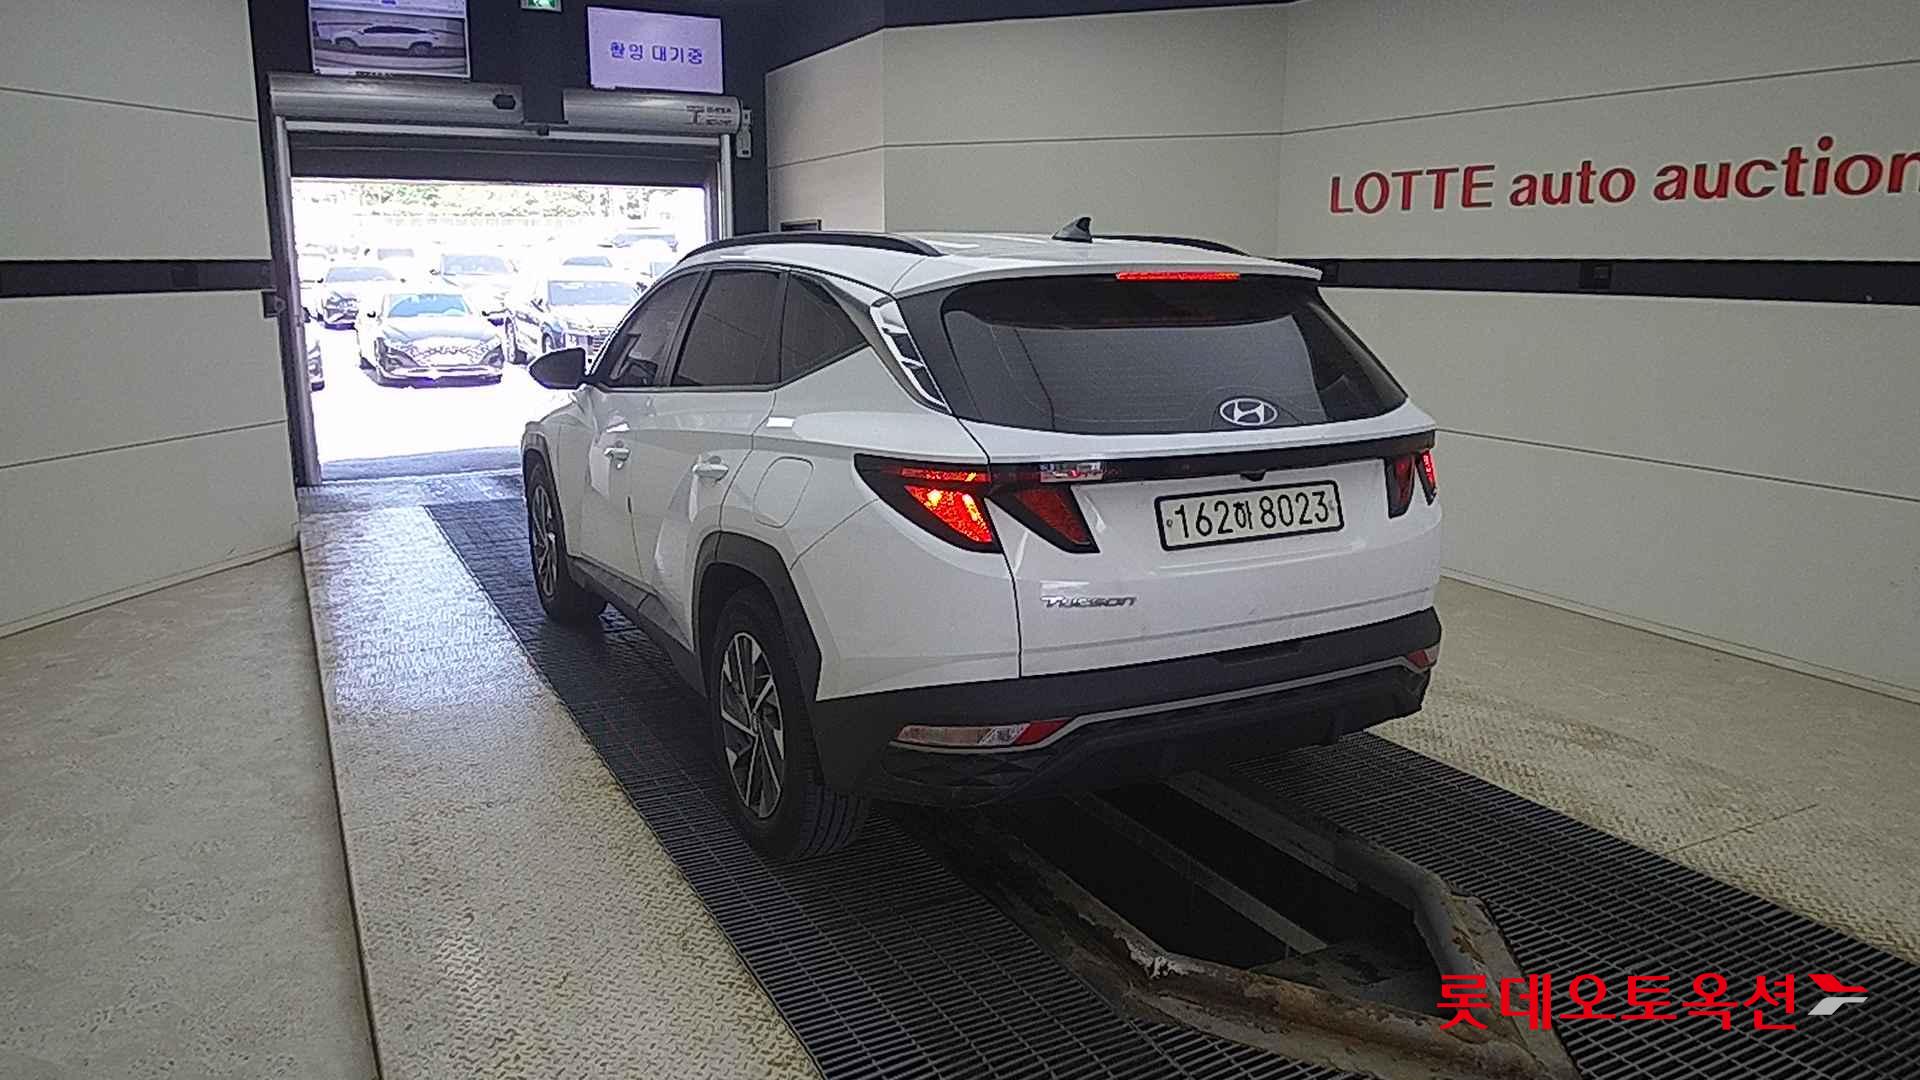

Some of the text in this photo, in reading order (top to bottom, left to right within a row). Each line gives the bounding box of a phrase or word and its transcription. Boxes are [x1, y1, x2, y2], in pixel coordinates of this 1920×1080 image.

[652, 45, 703, 65] 대기중
[1329, 164, 1496, 215] LOTTE
[1508, 160, 1637, 208] auto
